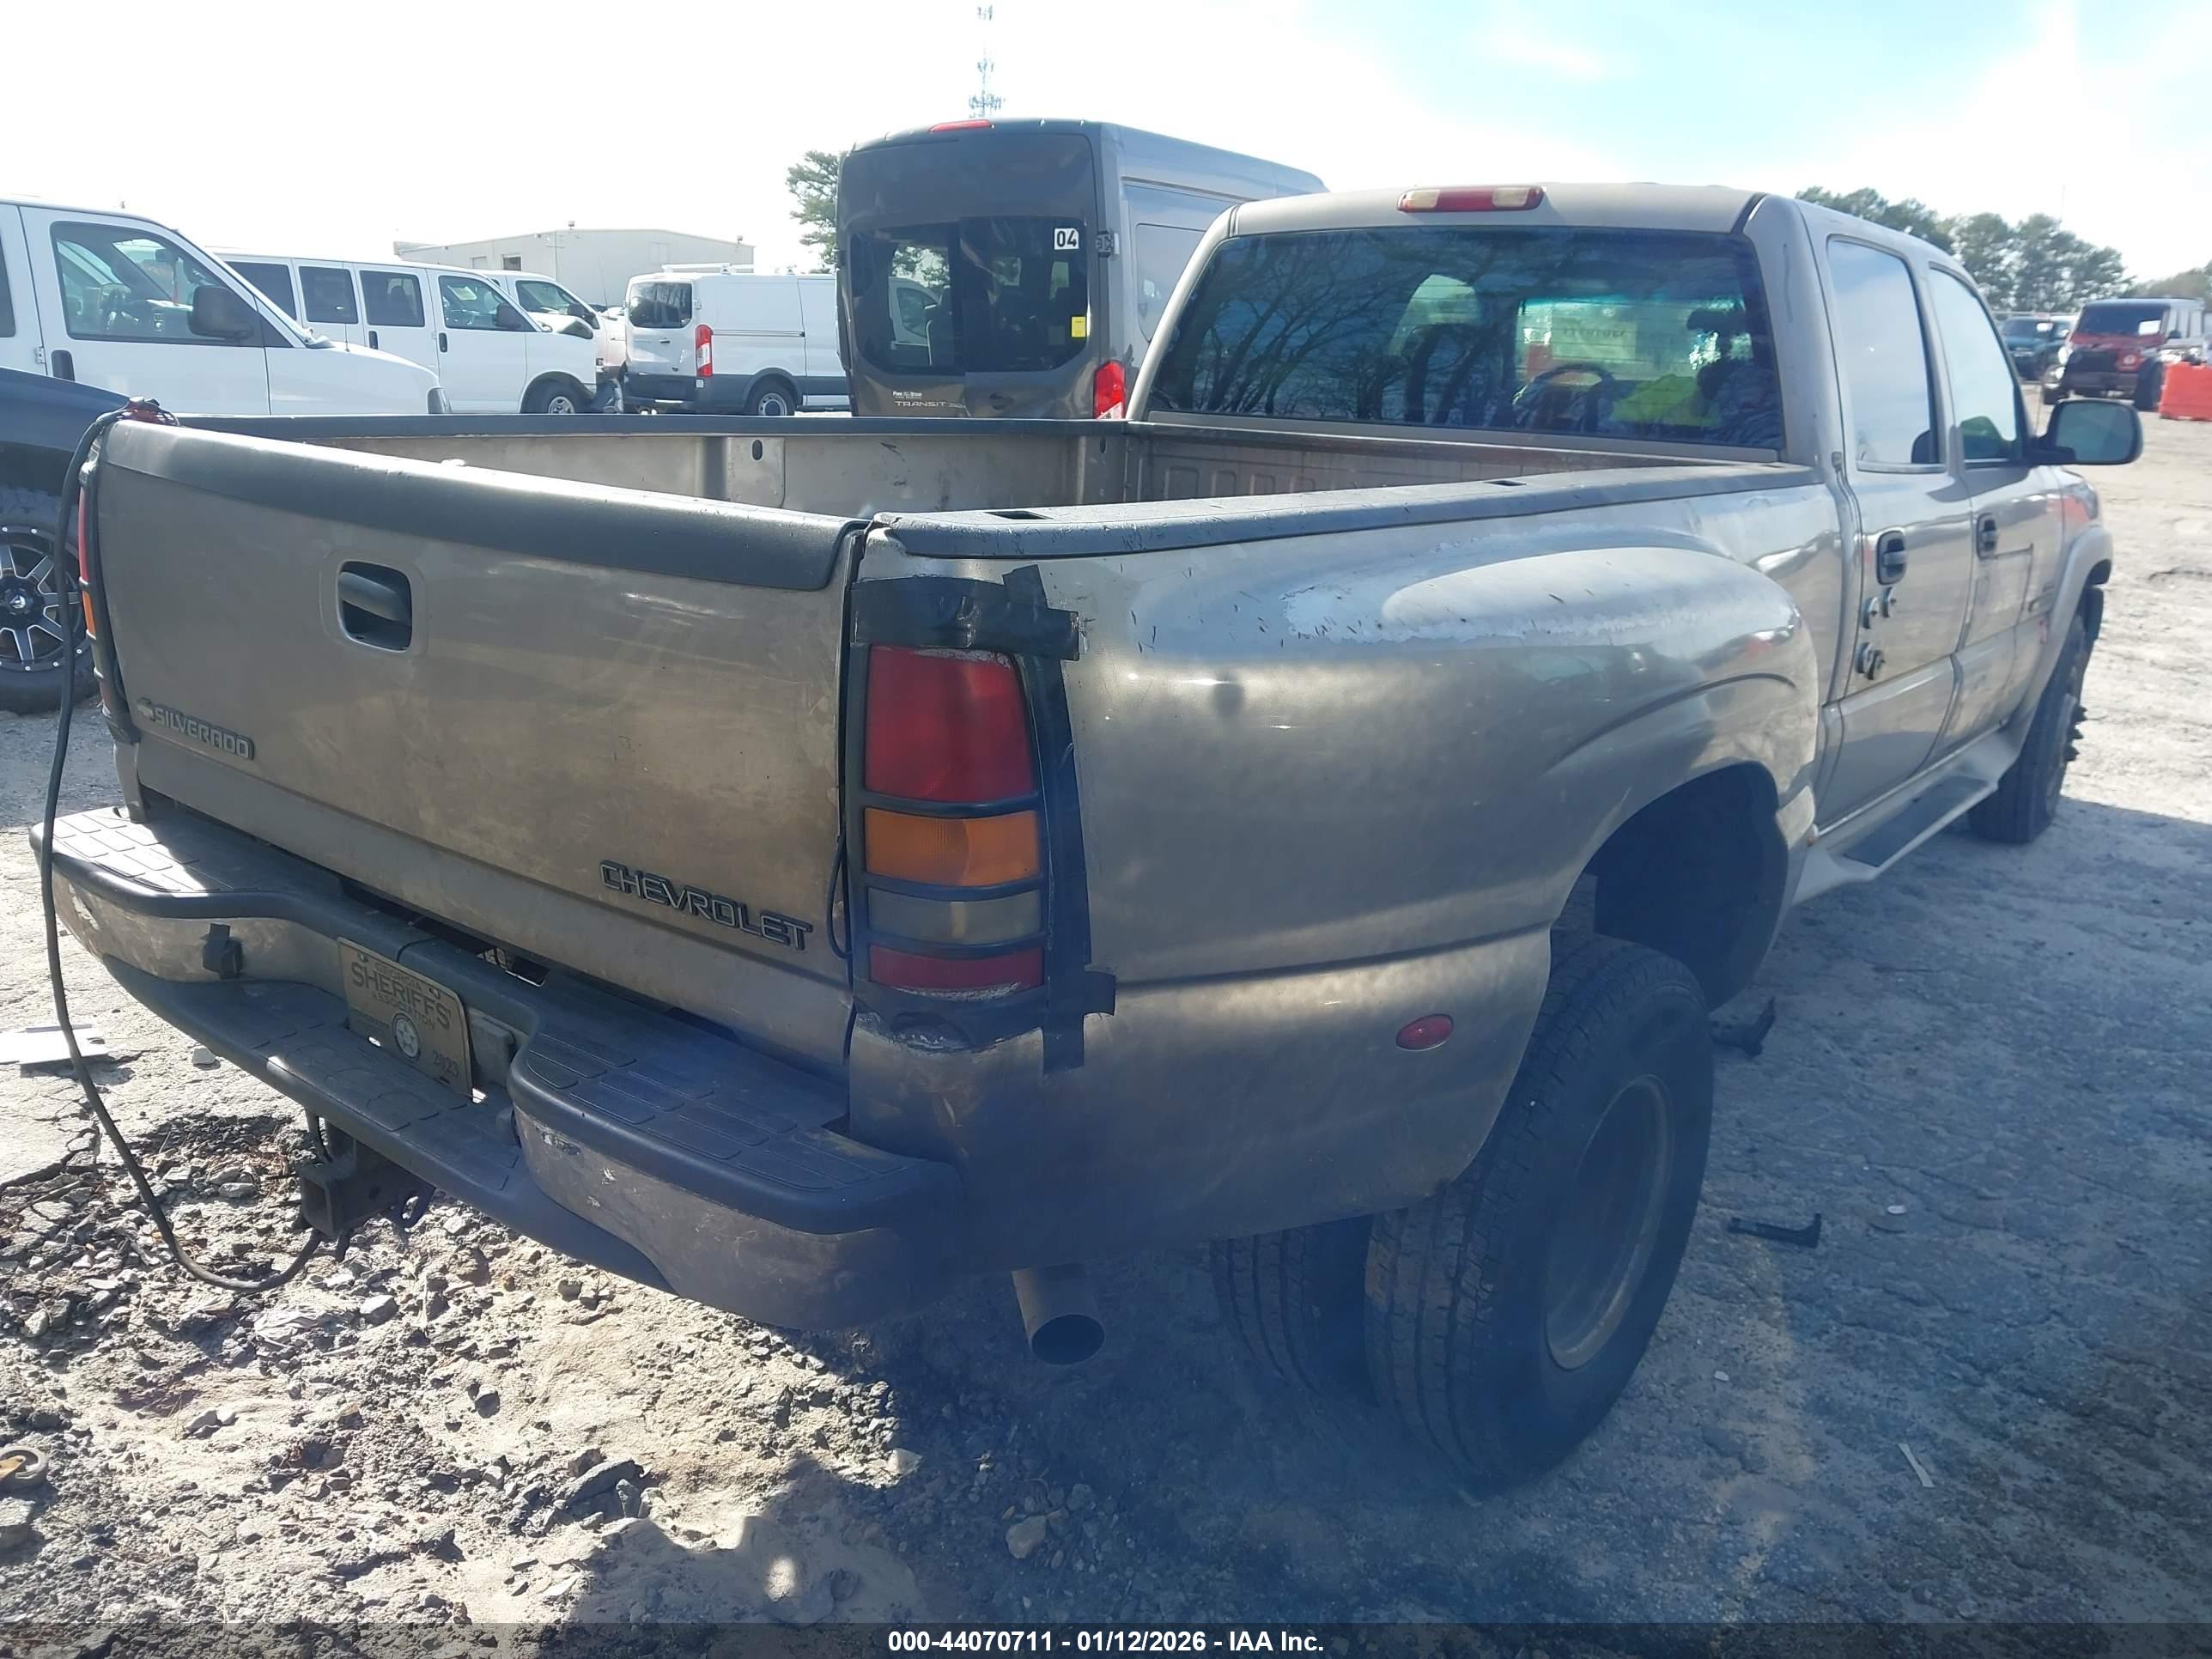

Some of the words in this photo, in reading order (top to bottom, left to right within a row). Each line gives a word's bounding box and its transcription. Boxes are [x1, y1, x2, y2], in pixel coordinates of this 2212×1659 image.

[1056, 230, 1077, 248] 04
[153, 707, 250, 758] SILVERADO
[600, 860, 812, 951] CHEVROLET
